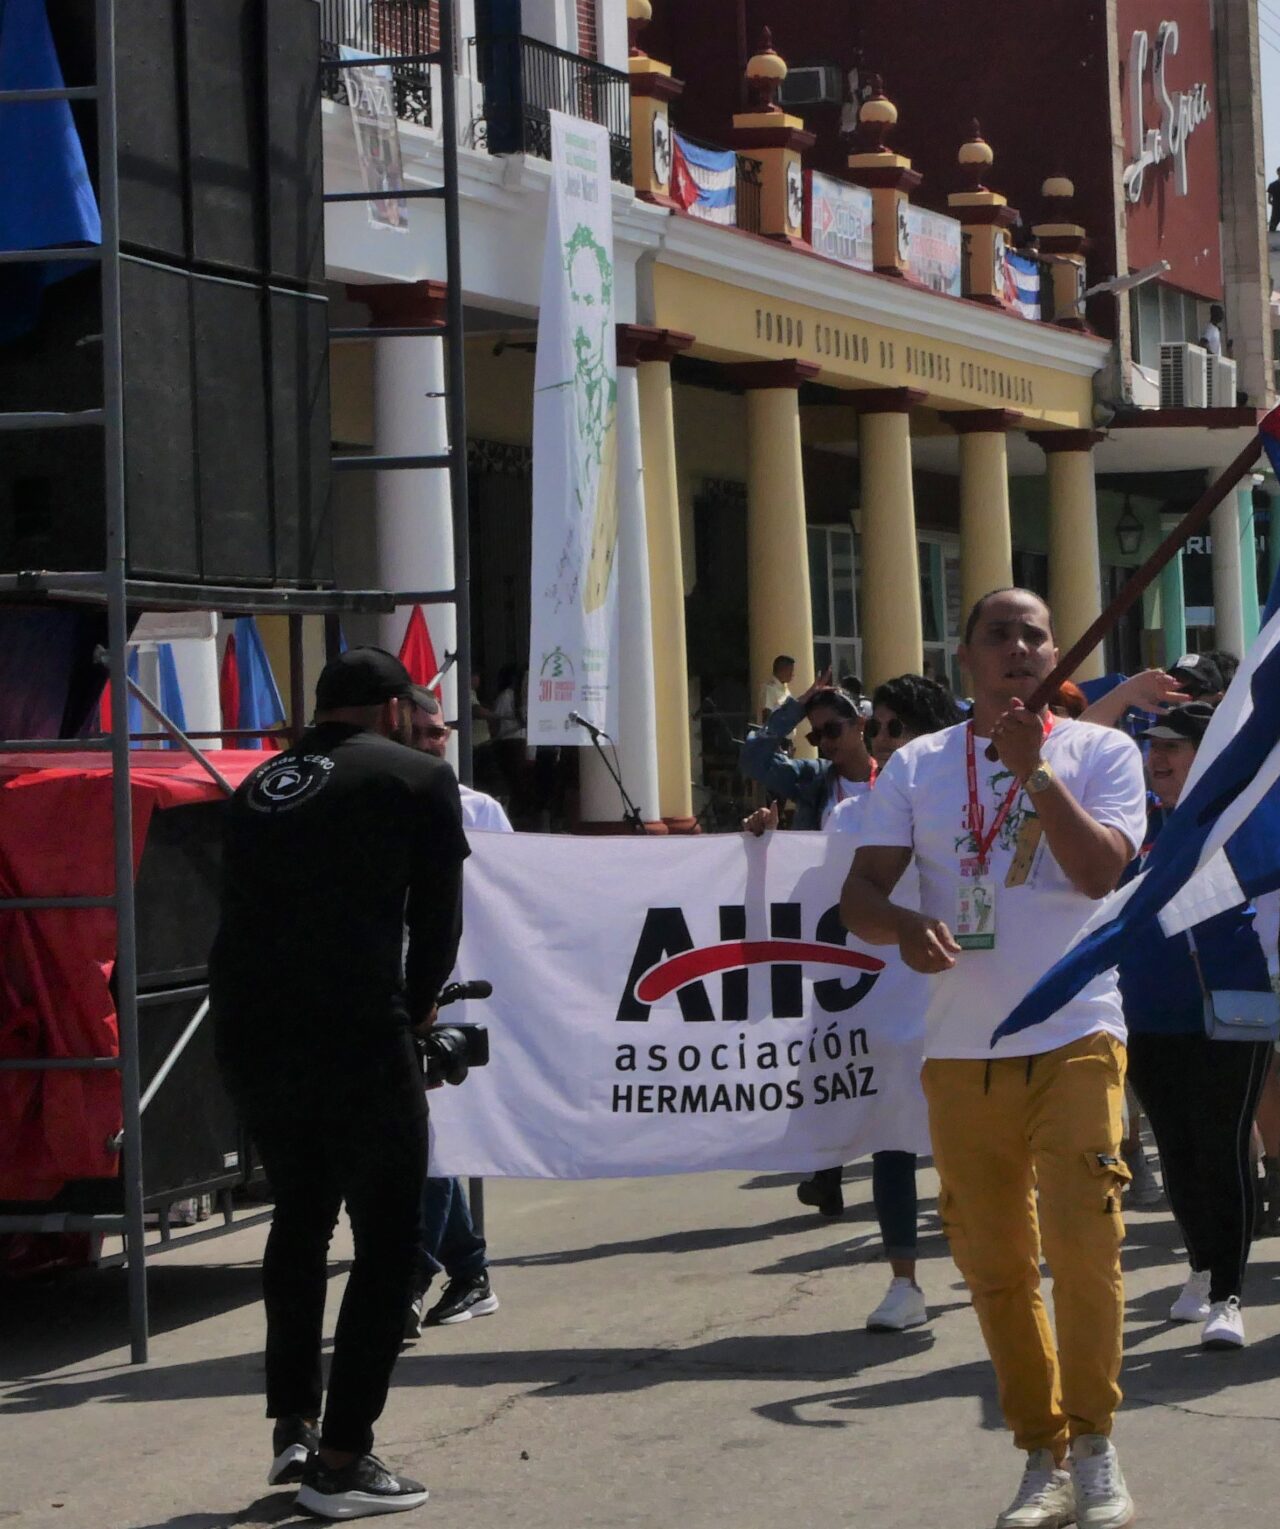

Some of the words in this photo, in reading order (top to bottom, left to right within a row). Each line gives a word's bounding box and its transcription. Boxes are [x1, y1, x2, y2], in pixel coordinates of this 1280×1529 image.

[755, 309, 803, 348] FONDO
[815, 324, 869, 364] CUBANO
[879, 341, 894, 369] DE
[905, 346, 950, 383] BIENES
[960, 361, 1033, 405] CULTURALES
[303, 754, 336, 770] CERO
[615, 1022, 869, 1071] asociación
[612, 1079, 804, 1113] HERMANOS
[814, 1063, 878, 1105] SAÍZ
